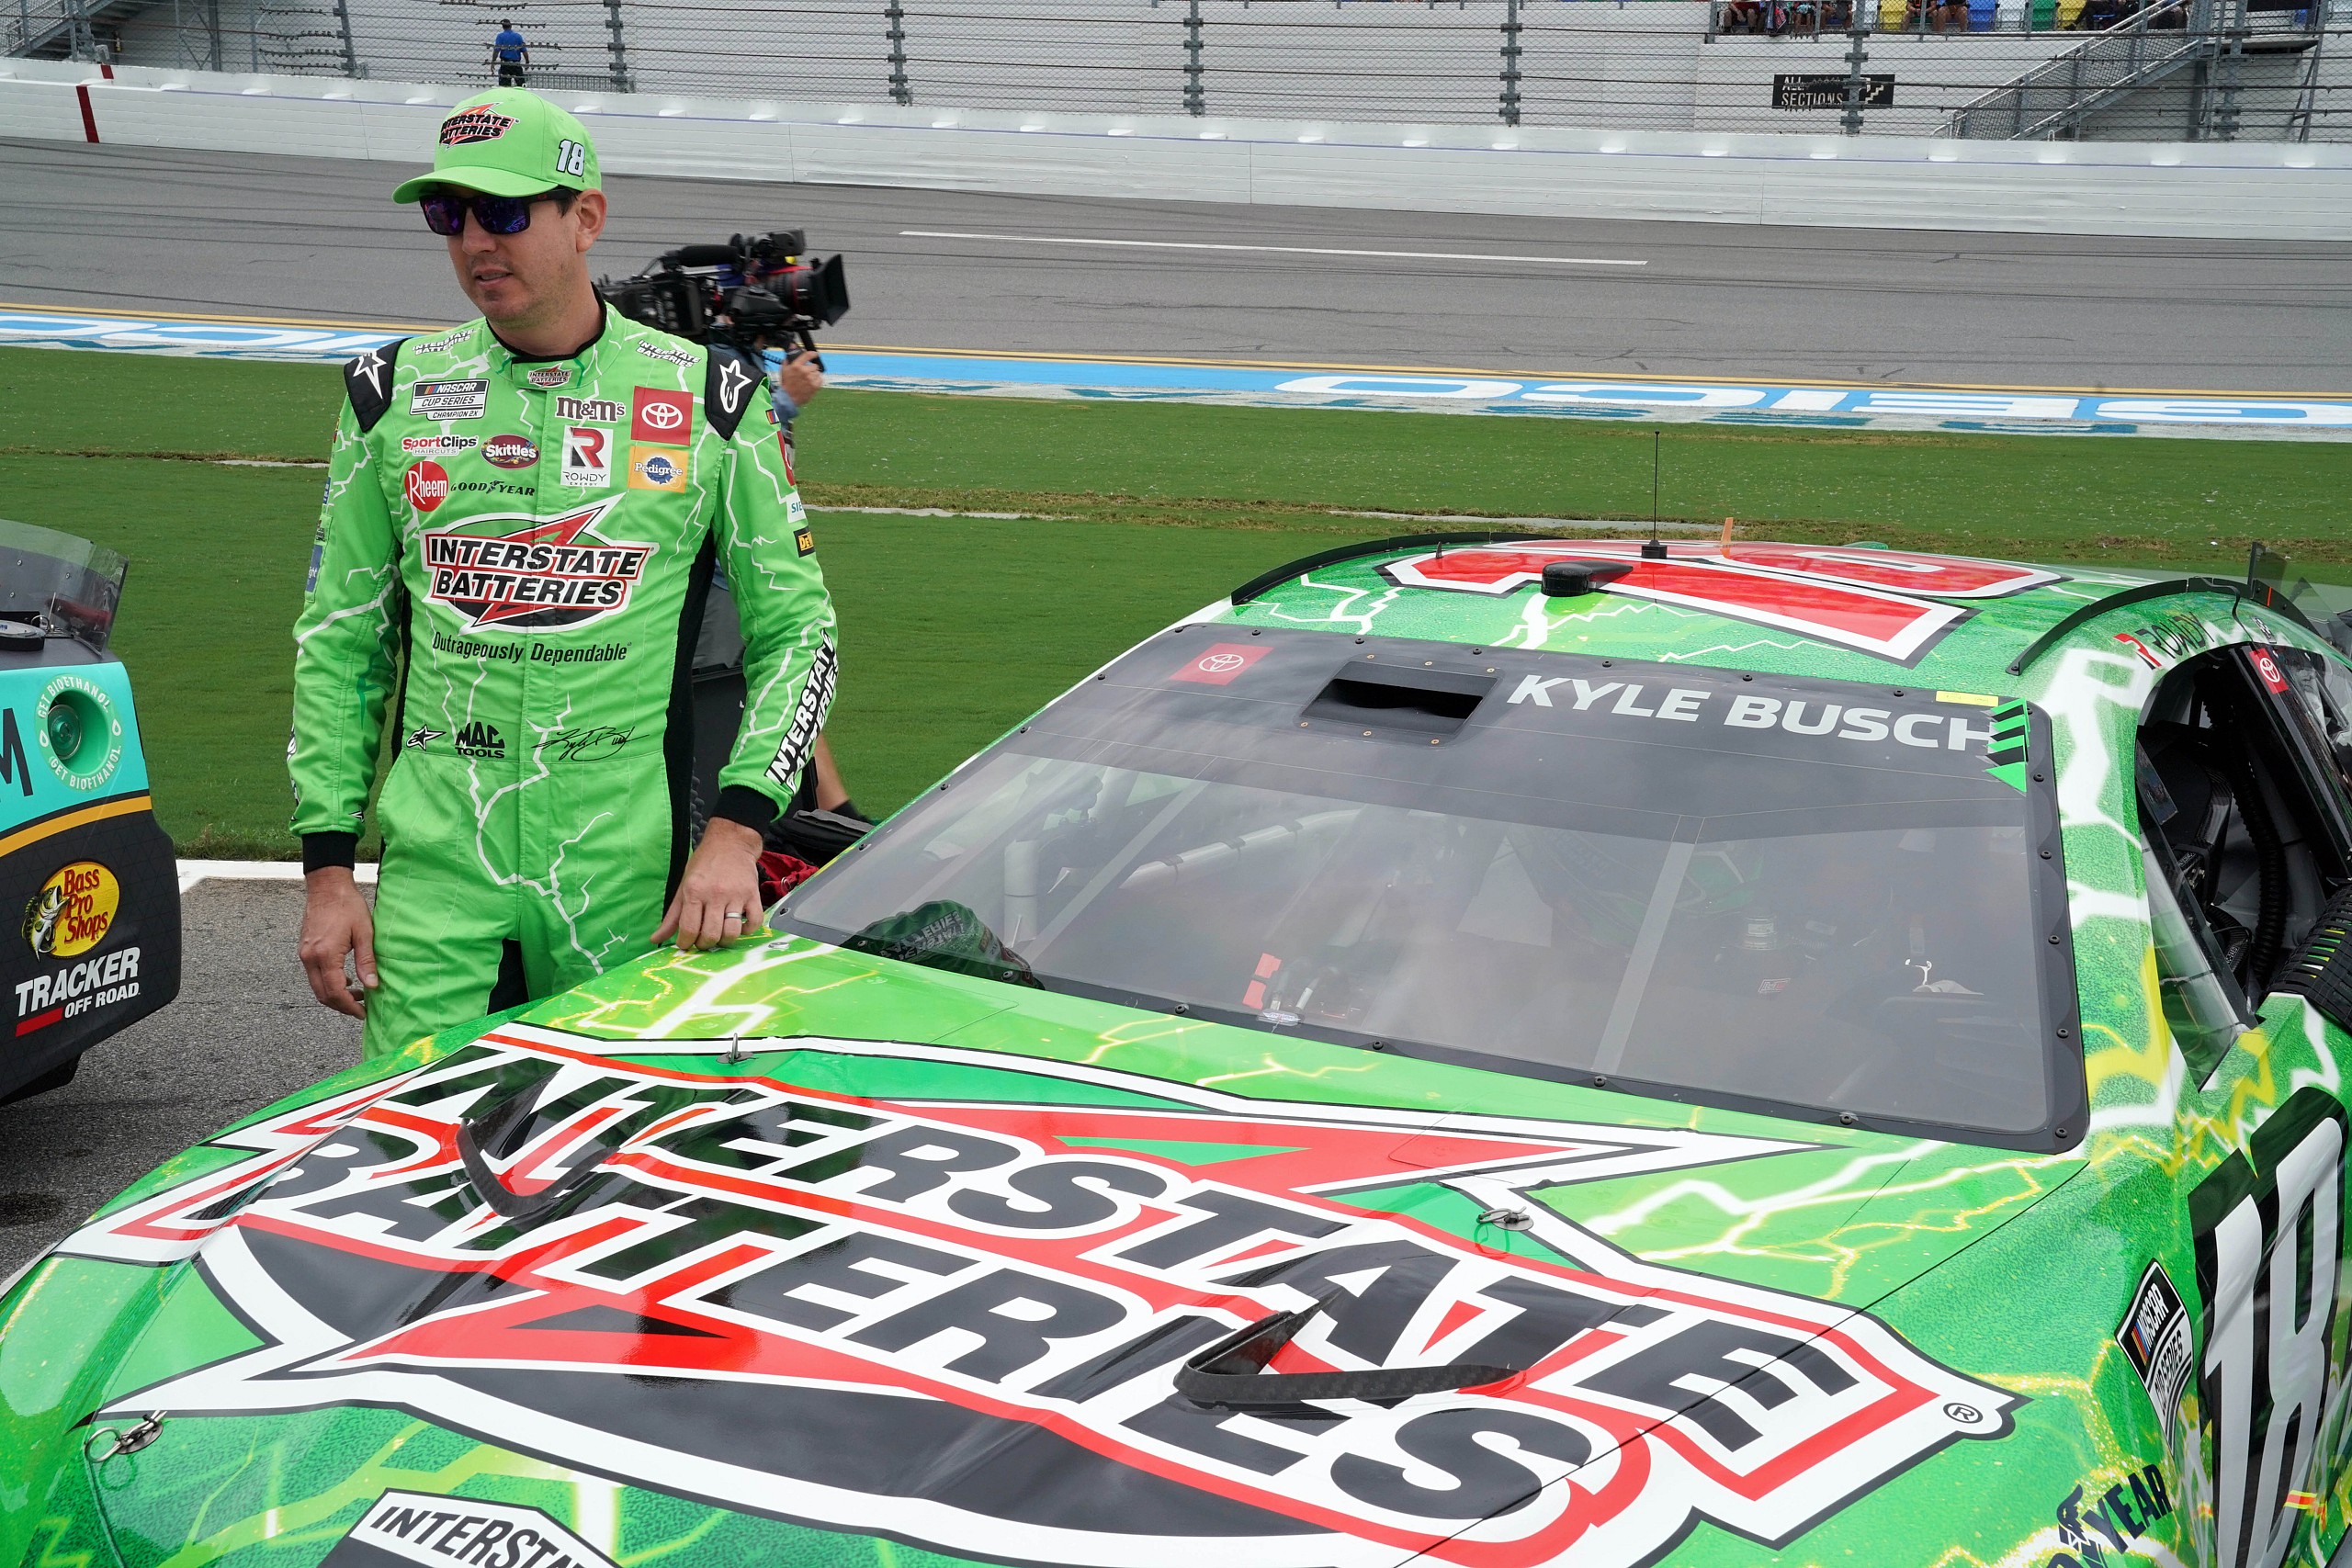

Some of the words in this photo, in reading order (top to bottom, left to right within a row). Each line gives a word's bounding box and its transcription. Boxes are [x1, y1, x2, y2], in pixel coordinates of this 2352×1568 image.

[1781, 93, 1844, 106] SECTIONS
[440, 125, 502, 141] ATTERIES
[441, 114, 511, 132] NTERSTATE
[556, 139, 585, 177] 18
[636, 346, 694, 367] BATTERIES
[638, 339, 702, 363] INTERSTATE
[422, 397, 441, 407] CUP
[441, 396, 475, 406] SERIES
[435, 382, 478, 394] NASCAR
[433, 411, 468, 419] CHAMPION
[486, 444, 537, 458] Skittles
[562, 471, 607, 482] ROWDY
[635, 462, 683, 476] Pedigree
[408, 462, 447, 505] Rheem
[431, 537, 643, 575] INTERSTATE
[436, 570, 623, 604] BATTERIES
[433, 632, 524, 663] Outrageously
[530, 643, 627, 666] Dependable
[2134, 611, 2215, 660] ROWDY
[38, 694, 51, 718] GET
[766, 628, 834, 783] INTERSTATE
[1506, 674, 1713, 722] KYLE
[1724, 694, 2000, 754] BUSCH
[457, 721, 505, 749] MAC
[455, 747, 505, 759] TOOLS
[50, 757, 68, 781] GET
[63, 869, 100, 897] Bass
[65, 893, 93, 919] Pro
[63, 911, 109, 945] Shops
[15, 946, 140, 1017] TRACKER
[64, 995, 93, 1019] OFF
[95, 982, 140, 1008] ROAD
[2137, 1282, 2170, 1353] NASCAR
[2203, 1114, 2345, 1568] 18
